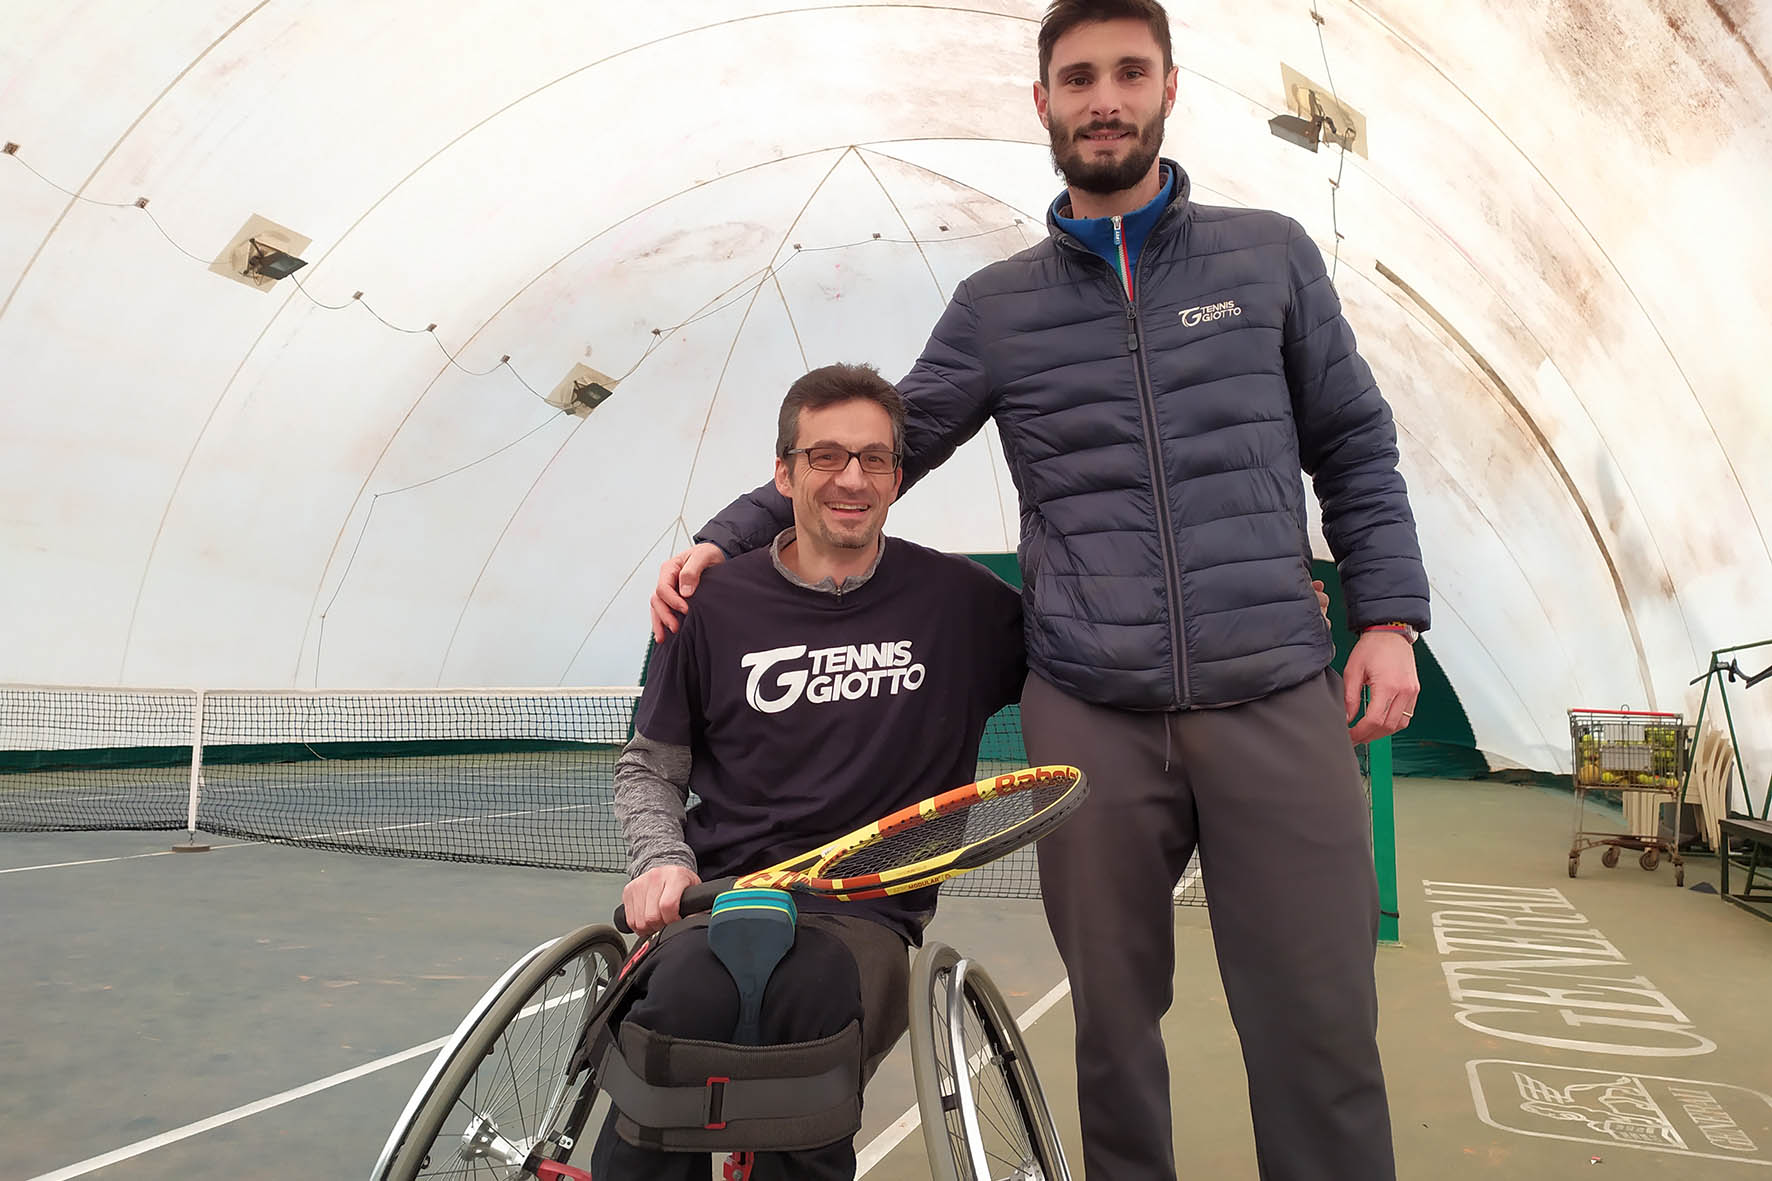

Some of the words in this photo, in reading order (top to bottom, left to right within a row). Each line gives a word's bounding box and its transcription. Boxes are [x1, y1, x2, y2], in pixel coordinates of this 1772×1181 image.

[1200, 300, 1235, 314] TENNIS
[1202, 306, 1242, 322] GIOTTO
[808, 640, 912, 675] TENNIS
[806, 663, 925, 704] GIOTTO
[1422, 879, 1718, 1057] GENERALI
